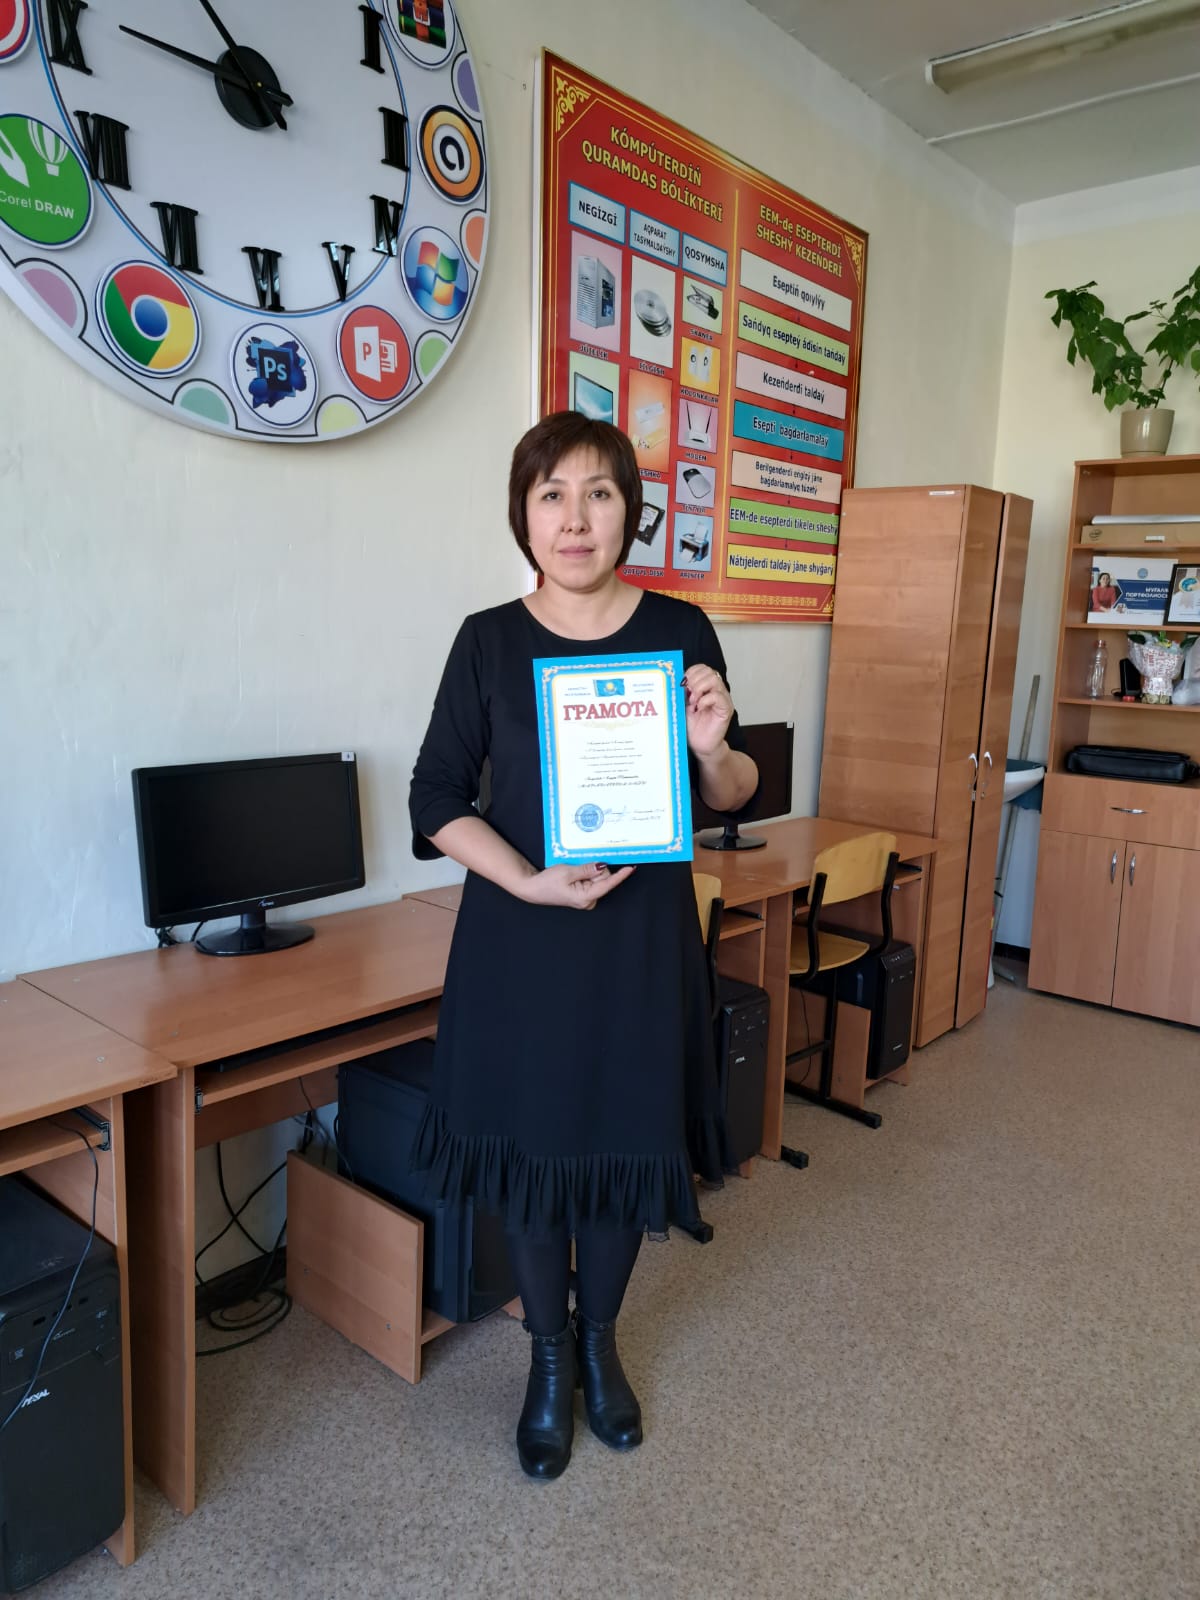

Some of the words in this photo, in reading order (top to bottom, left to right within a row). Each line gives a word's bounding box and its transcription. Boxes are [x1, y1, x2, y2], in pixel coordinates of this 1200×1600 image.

[581, 140, 657, 190] QURAMDAS
[35, 199, 75, 220] DRAW
[760, 204, 794, 233] EEM-de
[643, 223, 667, 240] AQPARAT
[684, 246, 725, 272] QOSYMSHA
[321, 241, 356, 302] V
[263, 358, 288, 381] Ps
[752, 416, 776, 433] Esepti
[730, 508, 758, 523] EEM-de
[760, 514, 793, 528] esepterdi
[562, 700, 659, 721] ГРАМОТА
